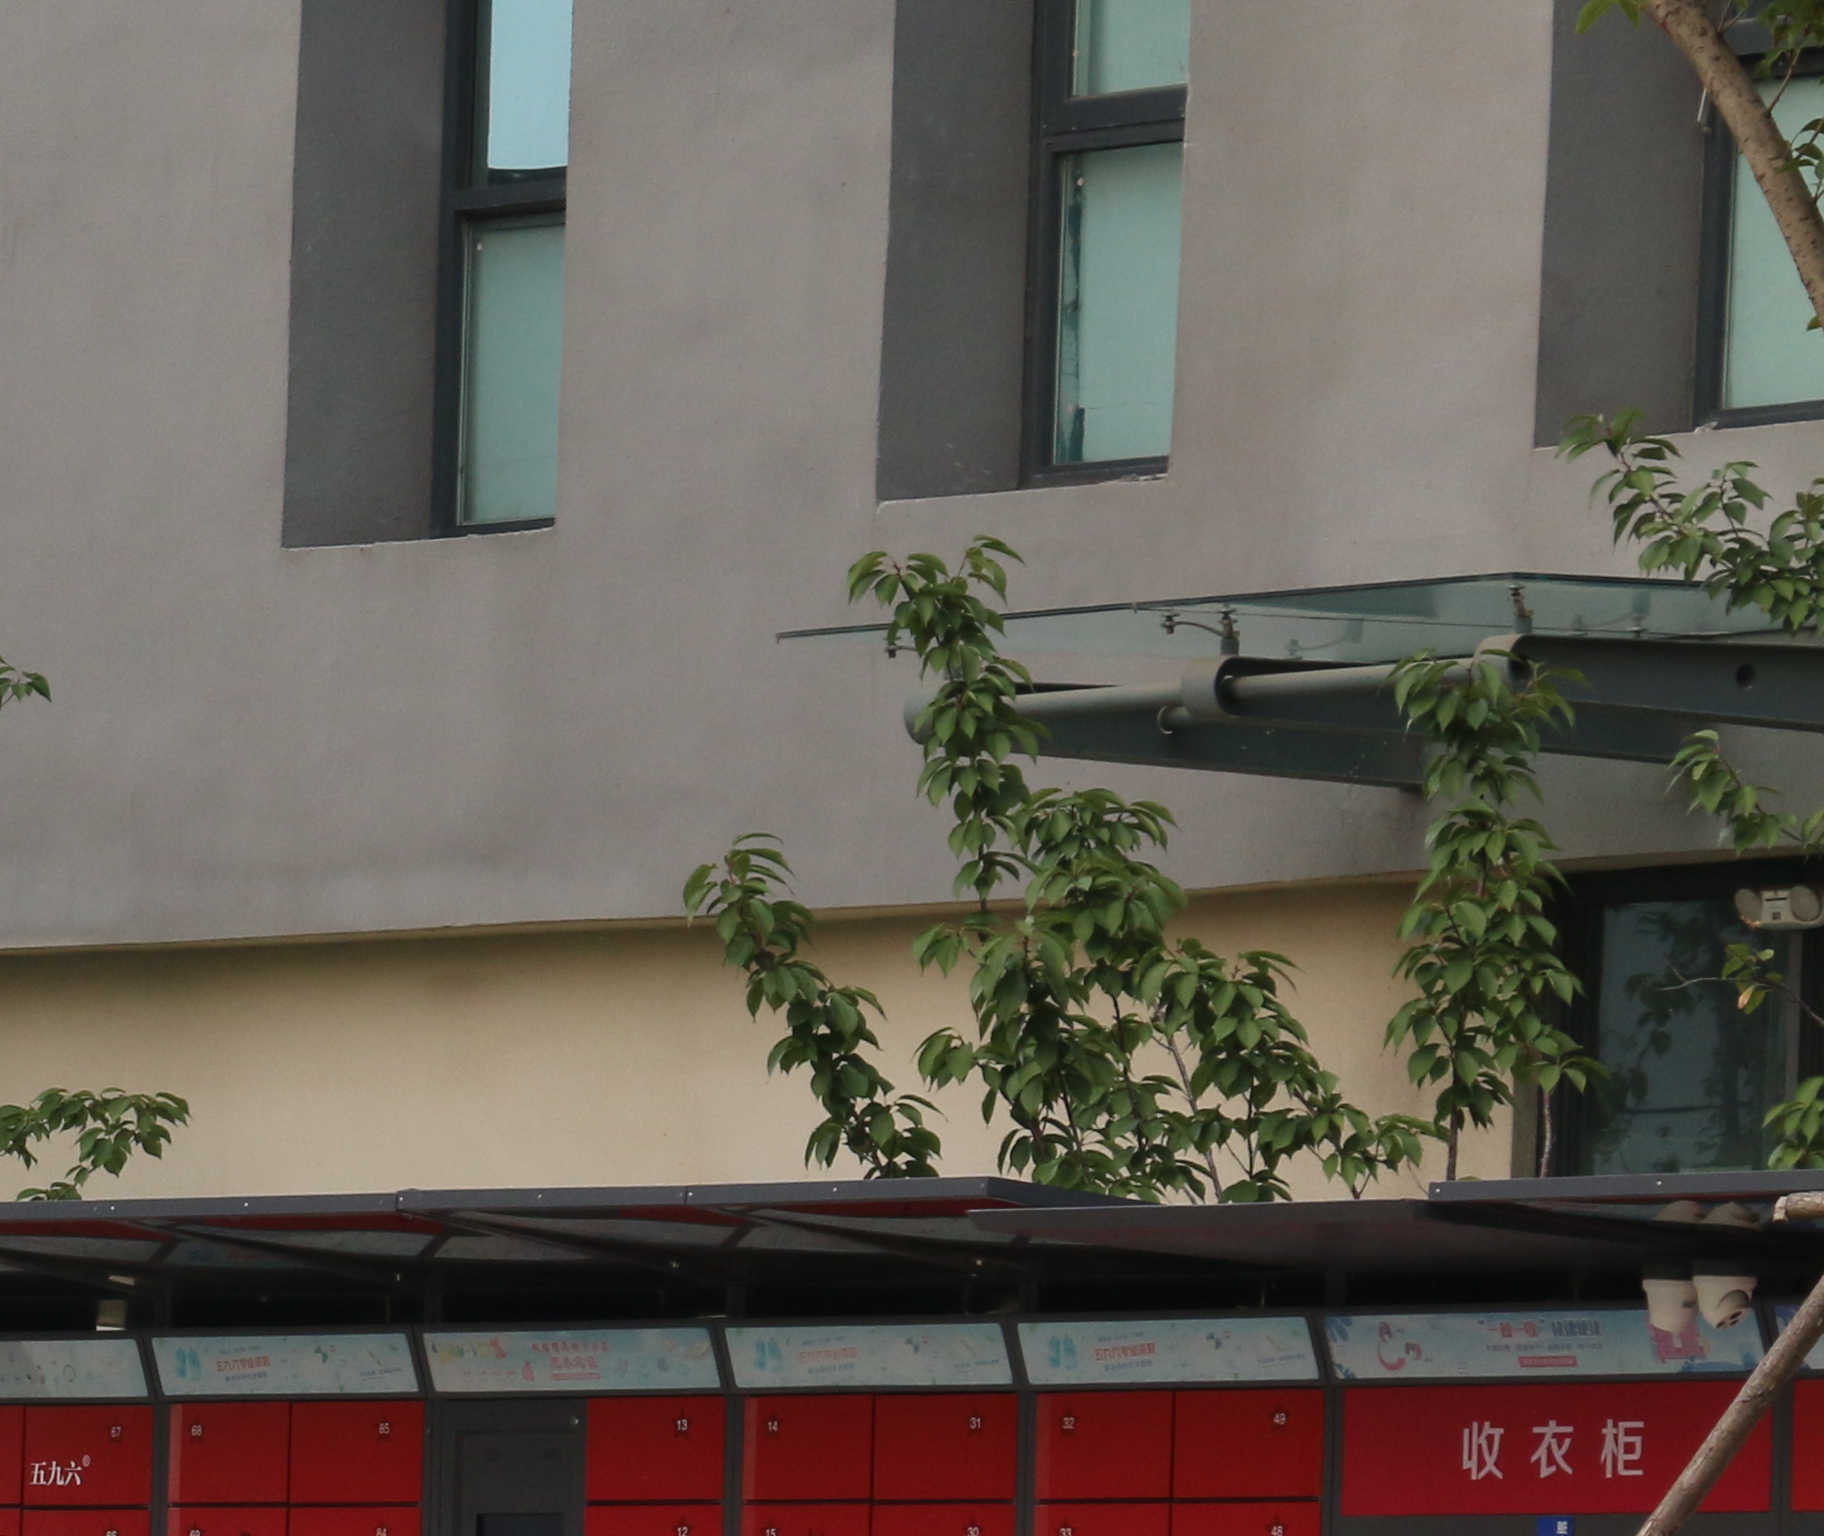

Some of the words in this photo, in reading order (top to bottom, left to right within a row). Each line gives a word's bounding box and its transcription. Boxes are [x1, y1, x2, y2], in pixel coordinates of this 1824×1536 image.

[676, 1418, 688, 1431] 13
[969, 1416, 981, 1430] 31
[1062, 1416, 1075, 1430] 32
[1273, 1412, 1287, 1426] 49
[110, 1426, 122, 1438] 67
[191, 1424, 203, 1437] 68
[378, 1422, 390, 1435] 85
[767, 1420, 779, 1432] 14
[1460, 1418, 1645, 1481] 收衣柜
